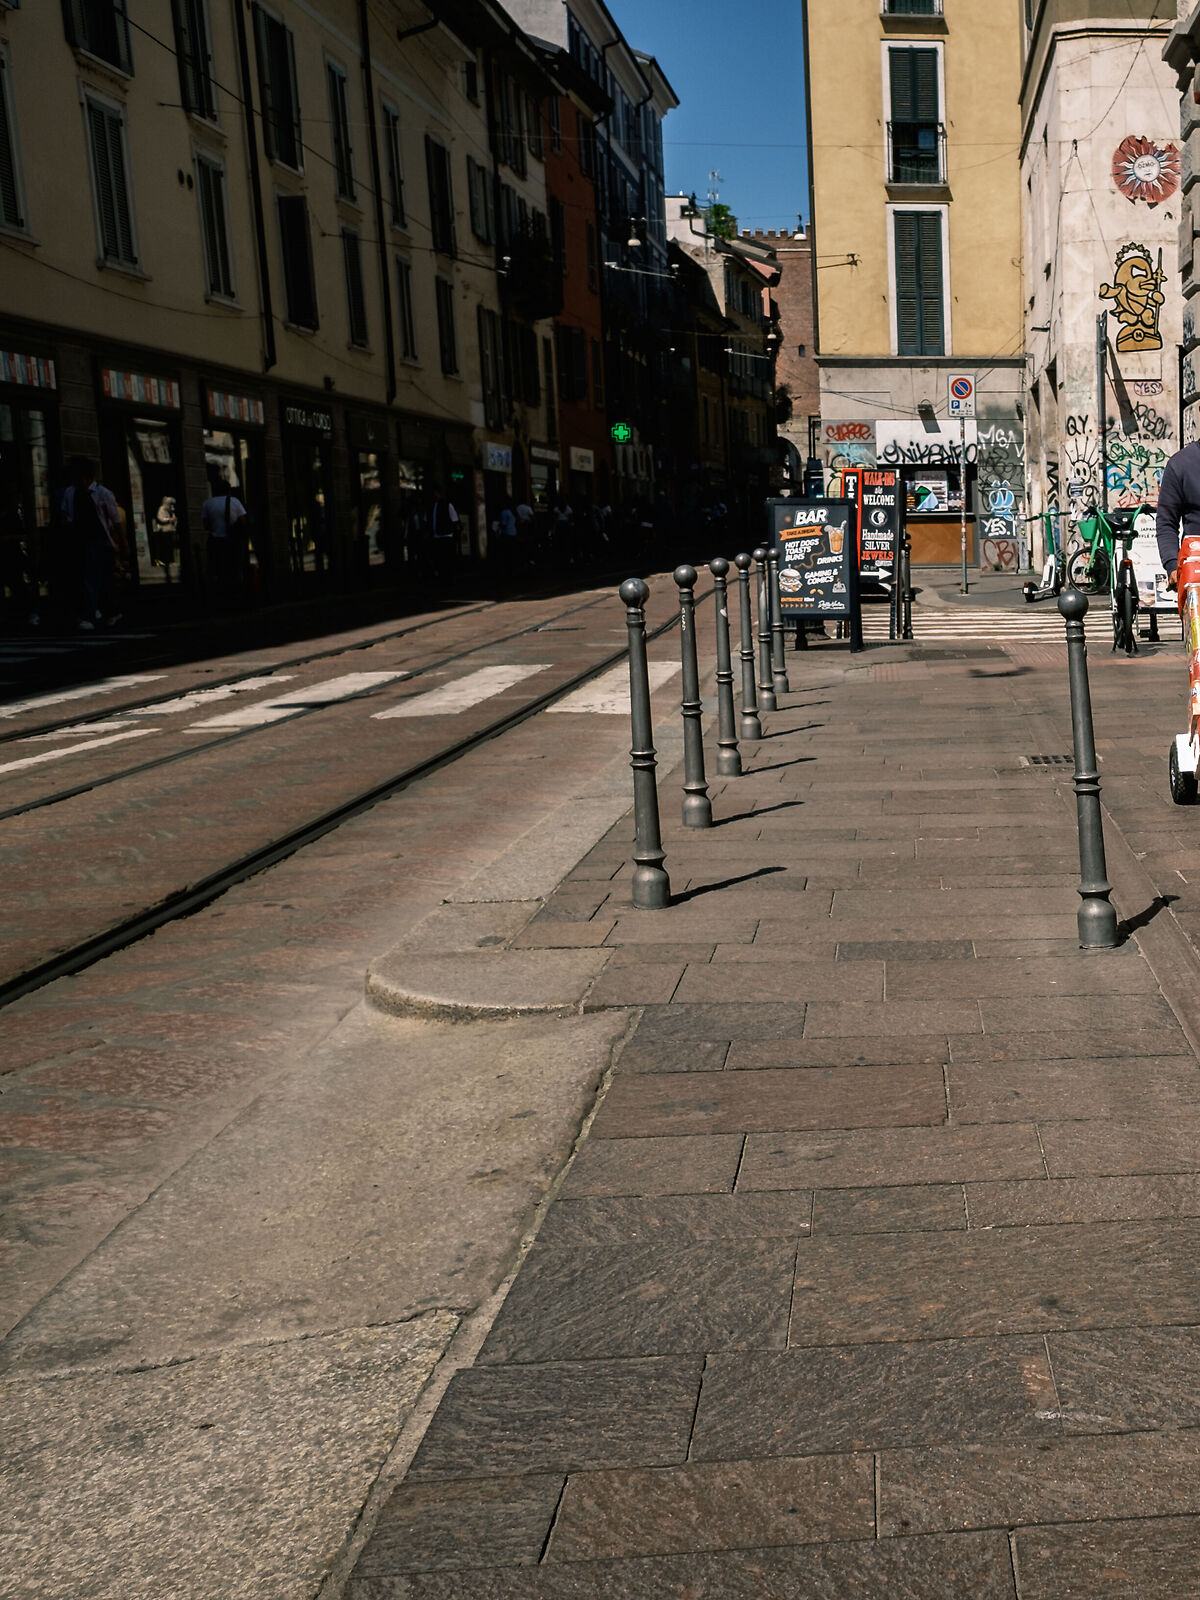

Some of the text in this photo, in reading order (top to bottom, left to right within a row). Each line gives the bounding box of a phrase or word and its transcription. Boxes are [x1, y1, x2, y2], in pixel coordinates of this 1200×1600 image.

[863, 494, 895, 506] WELCOME
[795, 509, 827, 525] BAR
[862, 529, 894, 540] Handmade
[785, 539, 819, 549] HOT DOGS
[864, 541, 890, 550] SILVER
[786, 546, 812, 555] TOASTS
[785, 553, 805, 561] BUNS
[817, 555, 843, 564] DRINKS
[861, 551, 894, 560] JEWELS
[805, 570, 832, 579] GAMING
[807, 576, 834, 585] COMICS
